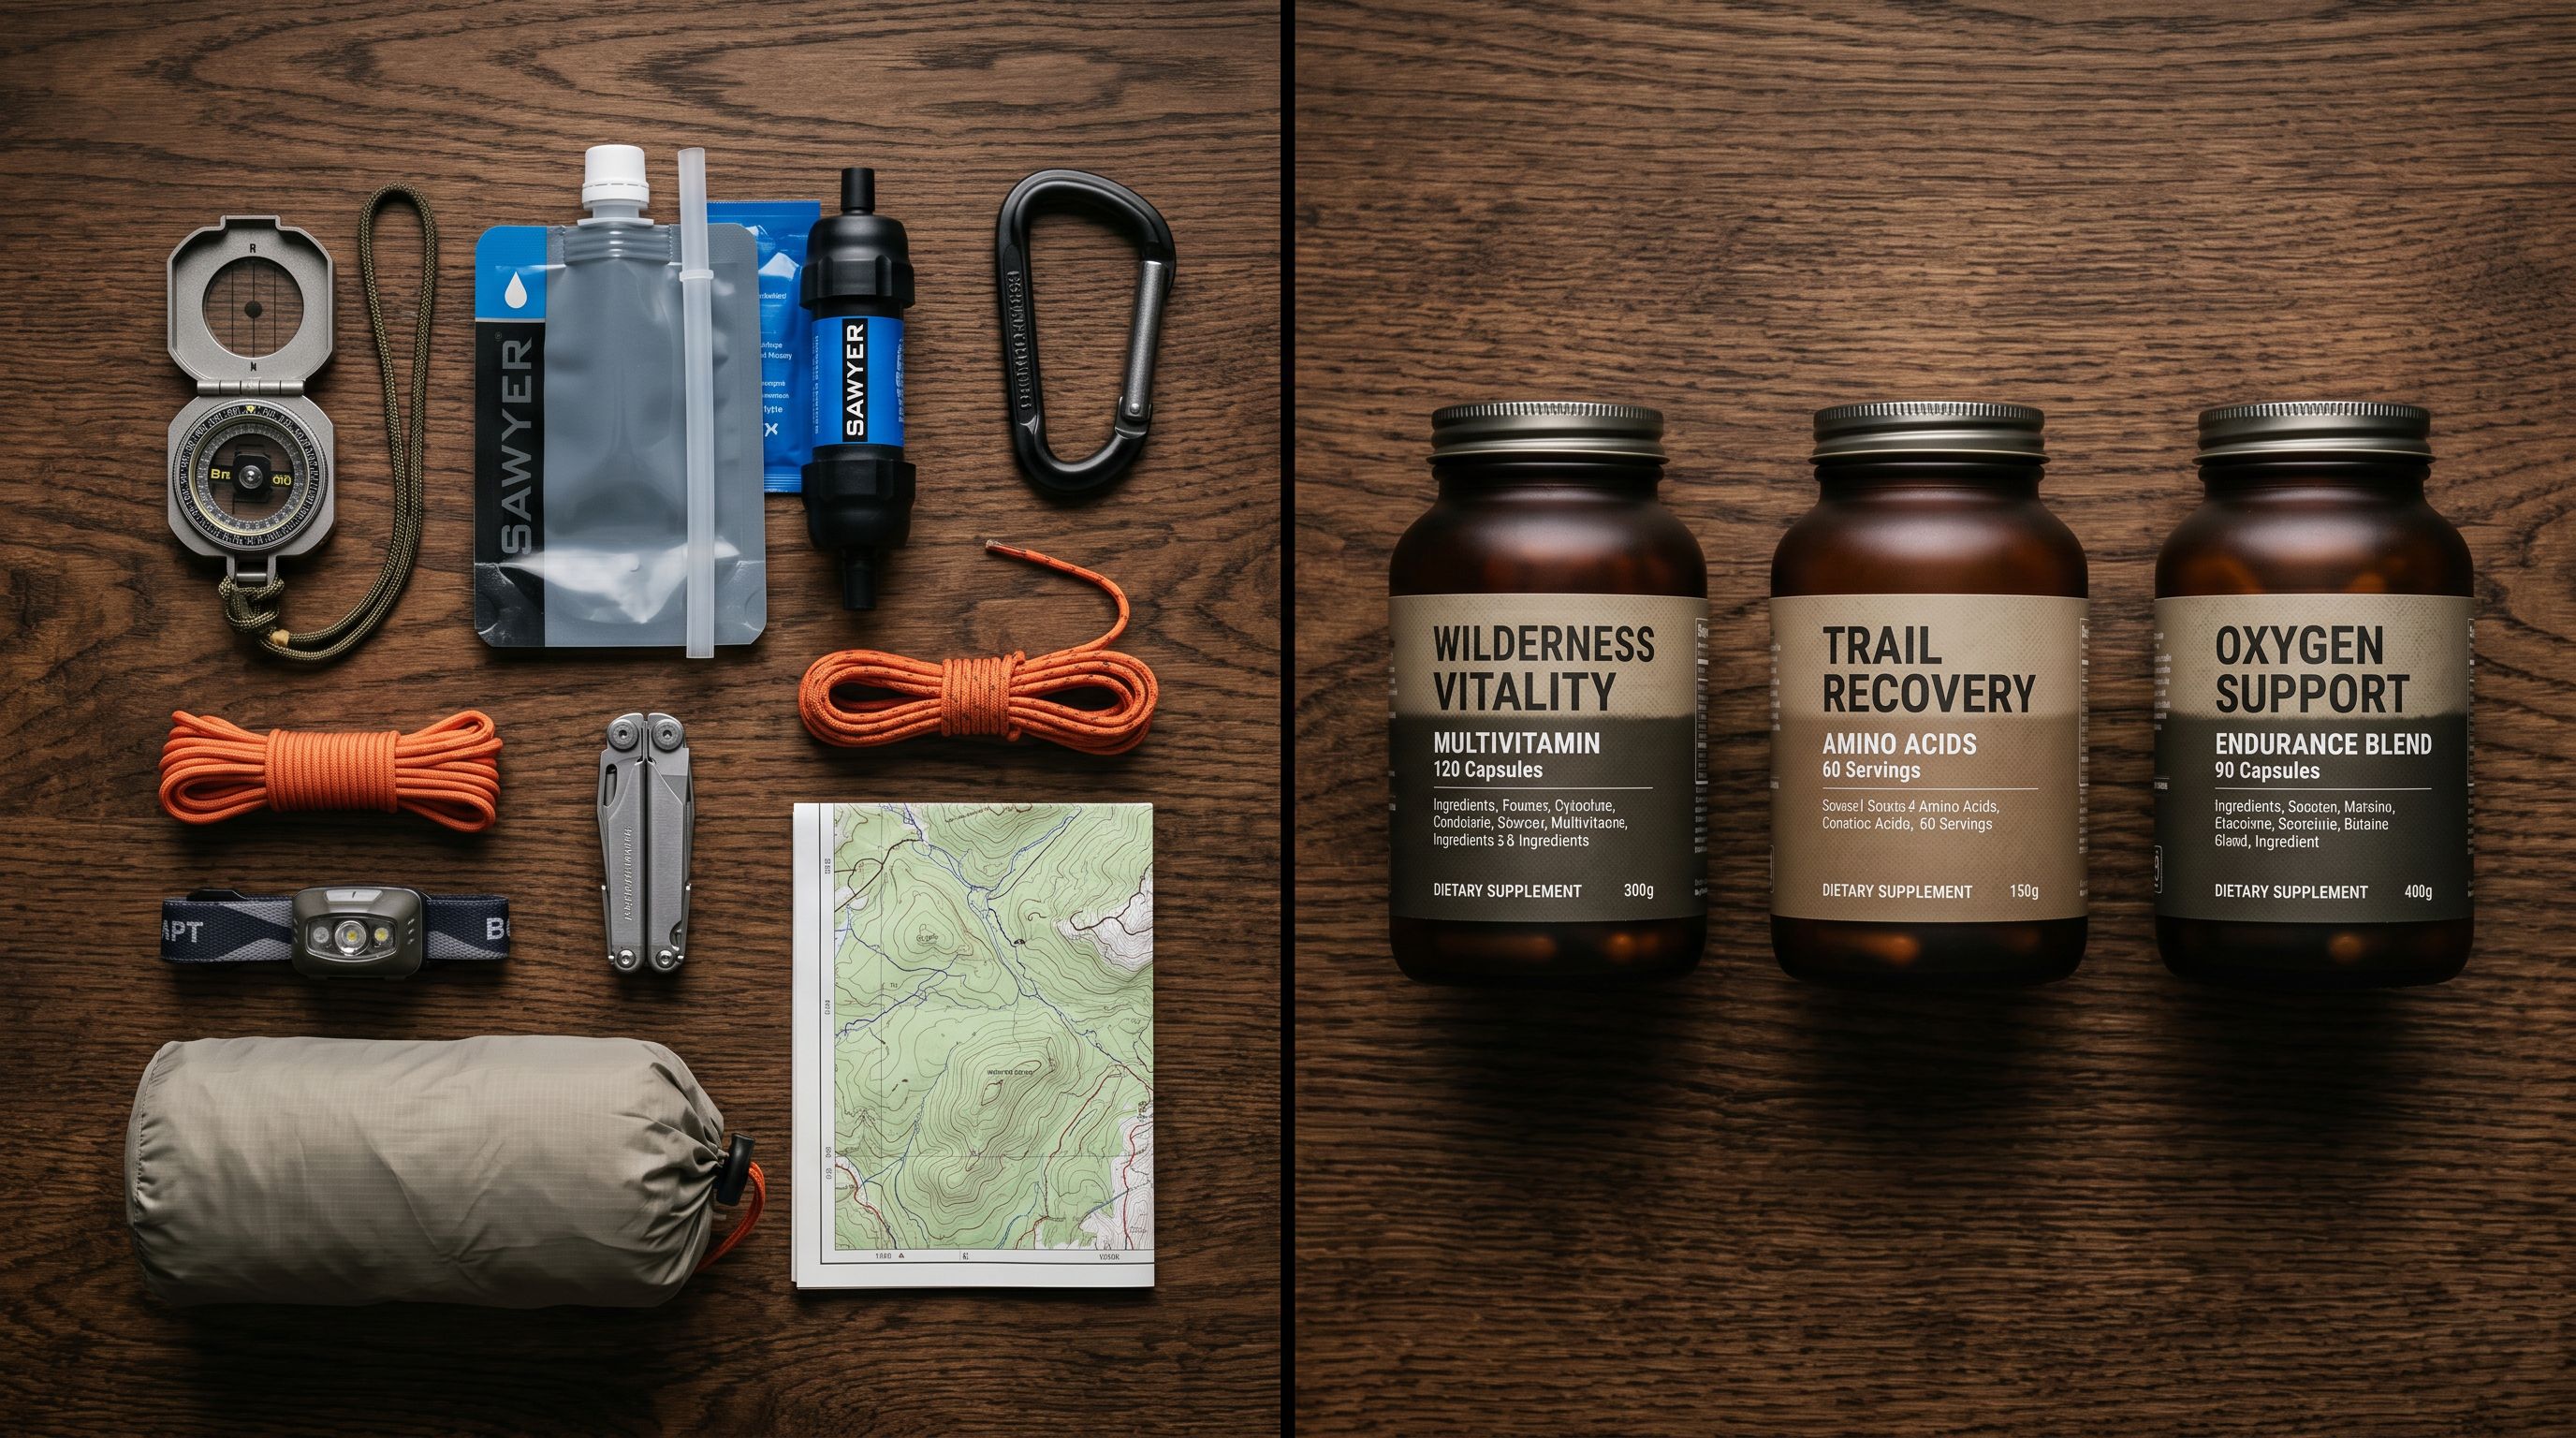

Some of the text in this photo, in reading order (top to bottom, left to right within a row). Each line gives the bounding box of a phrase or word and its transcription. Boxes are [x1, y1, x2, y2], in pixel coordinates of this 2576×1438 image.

[250, 243, 256, 253] R
[846, 324, 864, 436] SAWYER
[502, 337, 532, 555] SAWYER
[1434, 625, 1655, 663] WILDERNESS
[1823, 625, 1942, 665] TRAIL
[2217, 625, 2383, 665] OXYGEN
[1434, 672, 1617, 712] VITALITY
[1823, 674, 2037, 713] RECOVERY
[2216, 673, 2410, 713] SUPPORT
[1434, 732, 1600, 755] MULTIVITAMIN
[1823, 732, 1977, 755] AMINO ACIDS
[2216, 732, 2432, 756] ENDURANCE BLEND
[1434, 760, 1543, 783] 120 Capsules
[1823, 761, 1921, 783] 60 Servings
[2216, 761, 2320, 783] 90 Capsules
[1434, 799, 1499, 814] Ingredients,
[1919, 800, 1959, 813] Amino
[1963, 800, 1999, 814] Acids,
[2215, 800, 2285, 814] Ingredients,
[1920, 817, 1936, 829] 60
[1939, 817, 1993, 832] Servings
[1434, 833, 1494, 848] Ingredients
[1519, 834, 1589, 849] Ingredients
[2255, 835, 2320, 850] Ingredient
[1434, 883, 1654, 899] DIETARY SUPPLEMENT 300g
[1822, 884, 2039, 900] DIETARY SUPPLEMENT 150g
[2215, 884, 2433, 901] DIETARY SUPPLEMENT 400g
[487, 917, 510, 940] B
